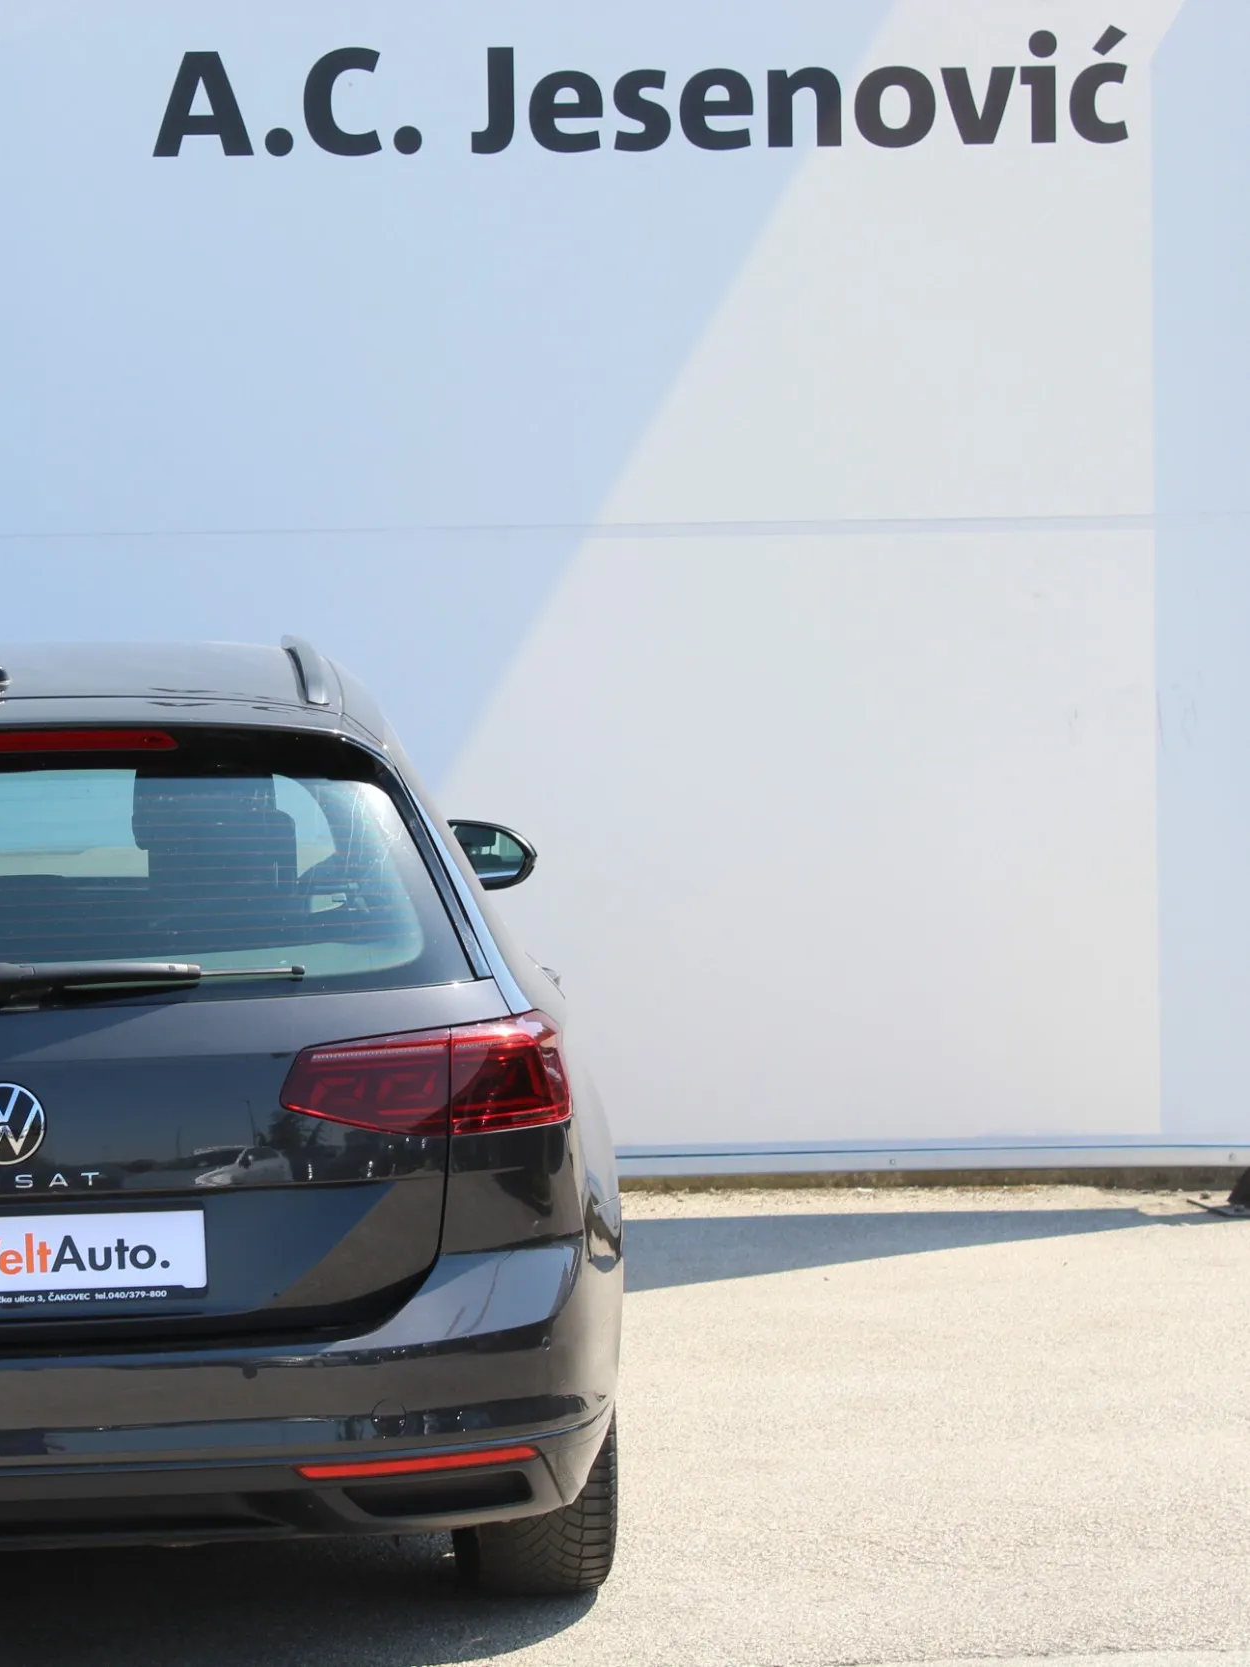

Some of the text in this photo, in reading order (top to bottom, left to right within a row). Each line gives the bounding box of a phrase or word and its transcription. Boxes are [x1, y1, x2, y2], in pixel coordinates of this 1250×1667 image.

[152, 25, 1129, 158] A.C. Jesenović
[14, 1295, 35, 1303] ulica
[37, 1295, 46, 1303] 3,
[48, 1292, 90, 1302] ČAKOVEC
